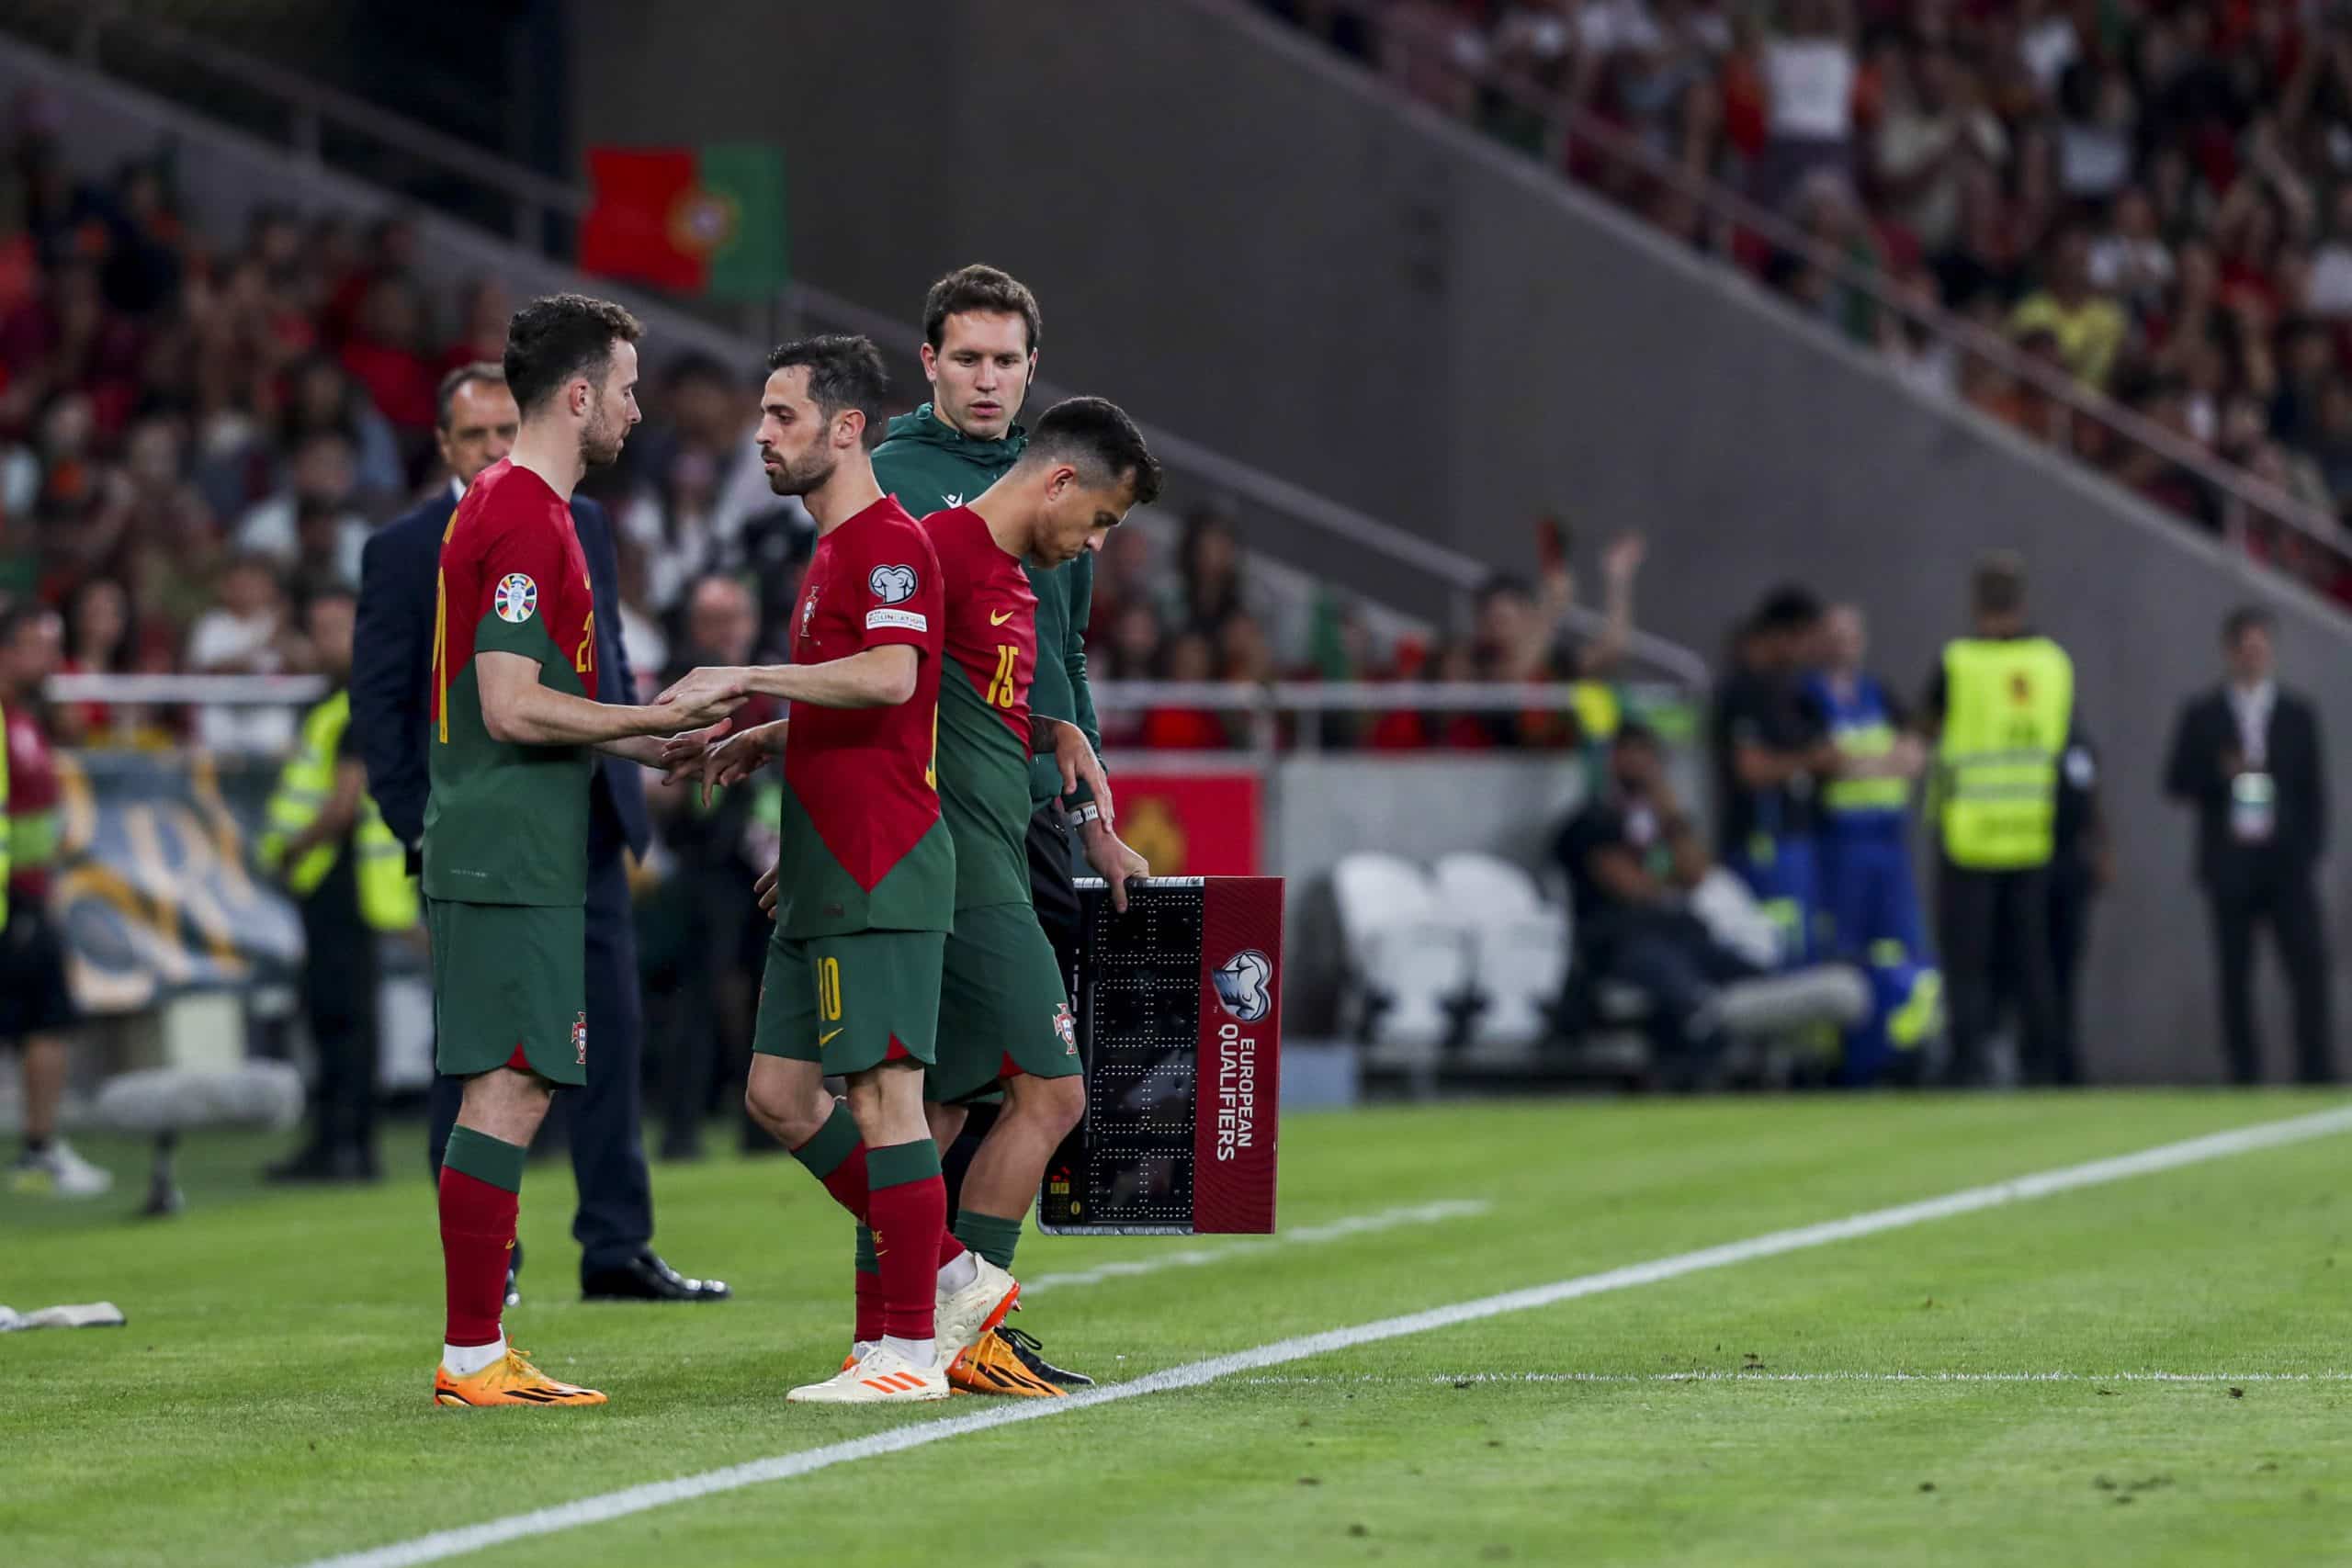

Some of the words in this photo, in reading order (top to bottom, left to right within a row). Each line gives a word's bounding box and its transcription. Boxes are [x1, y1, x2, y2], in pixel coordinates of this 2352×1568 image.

[987, 645, 1019, 708] 15
[818, 957, 841, 1021] 10
[1217, 1023, 1238, 1161] QUALIFIERS
[1238, 1038, 1255, 1147] EUROPEAN
